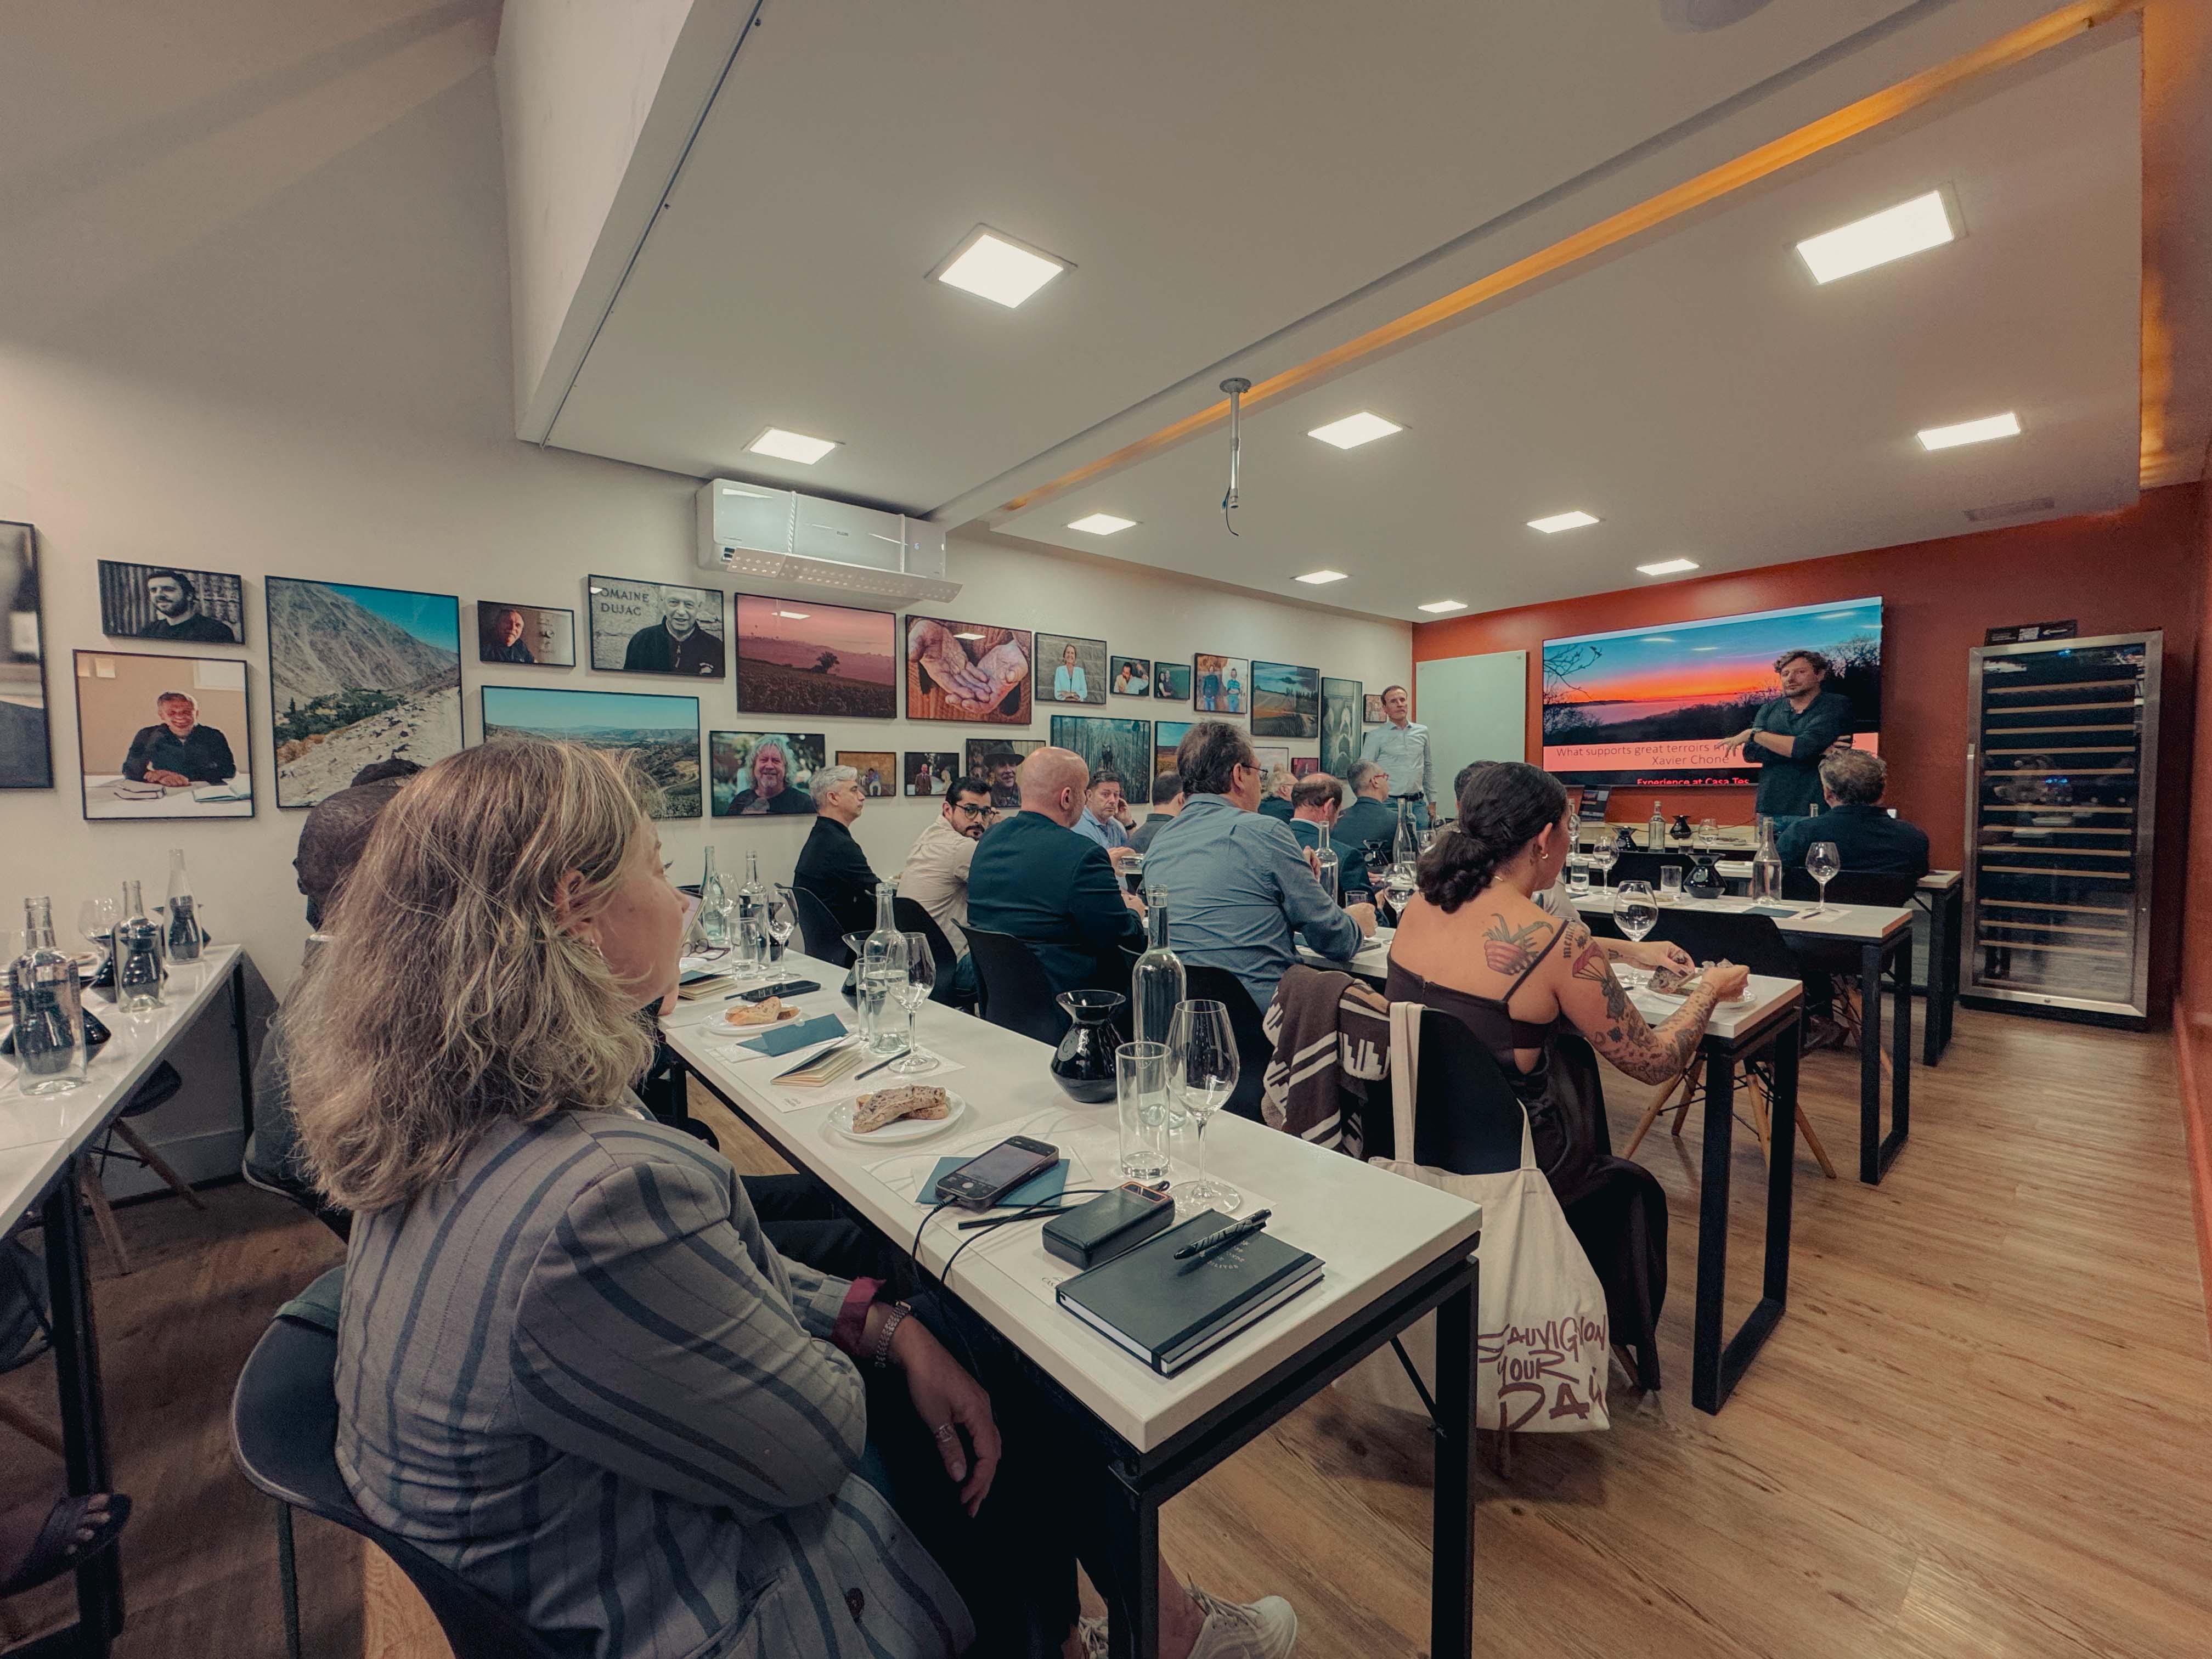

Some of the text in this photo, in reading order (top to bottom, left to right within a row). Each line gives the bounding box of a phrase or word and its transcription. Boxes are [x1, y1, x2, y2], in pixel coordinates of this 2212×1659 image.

[601, 602, 641, 616] DUJAC
[1556, 747, 1583, 757] What
[1585, 746, 1632, 757] supports
[1634, 744, 1663, 756] great
[1667, 743, 1709, 753] terroirs
[1652, 755, 1687, 765] Xavier
[1497, 1349, 1579, 1386] YOUR
